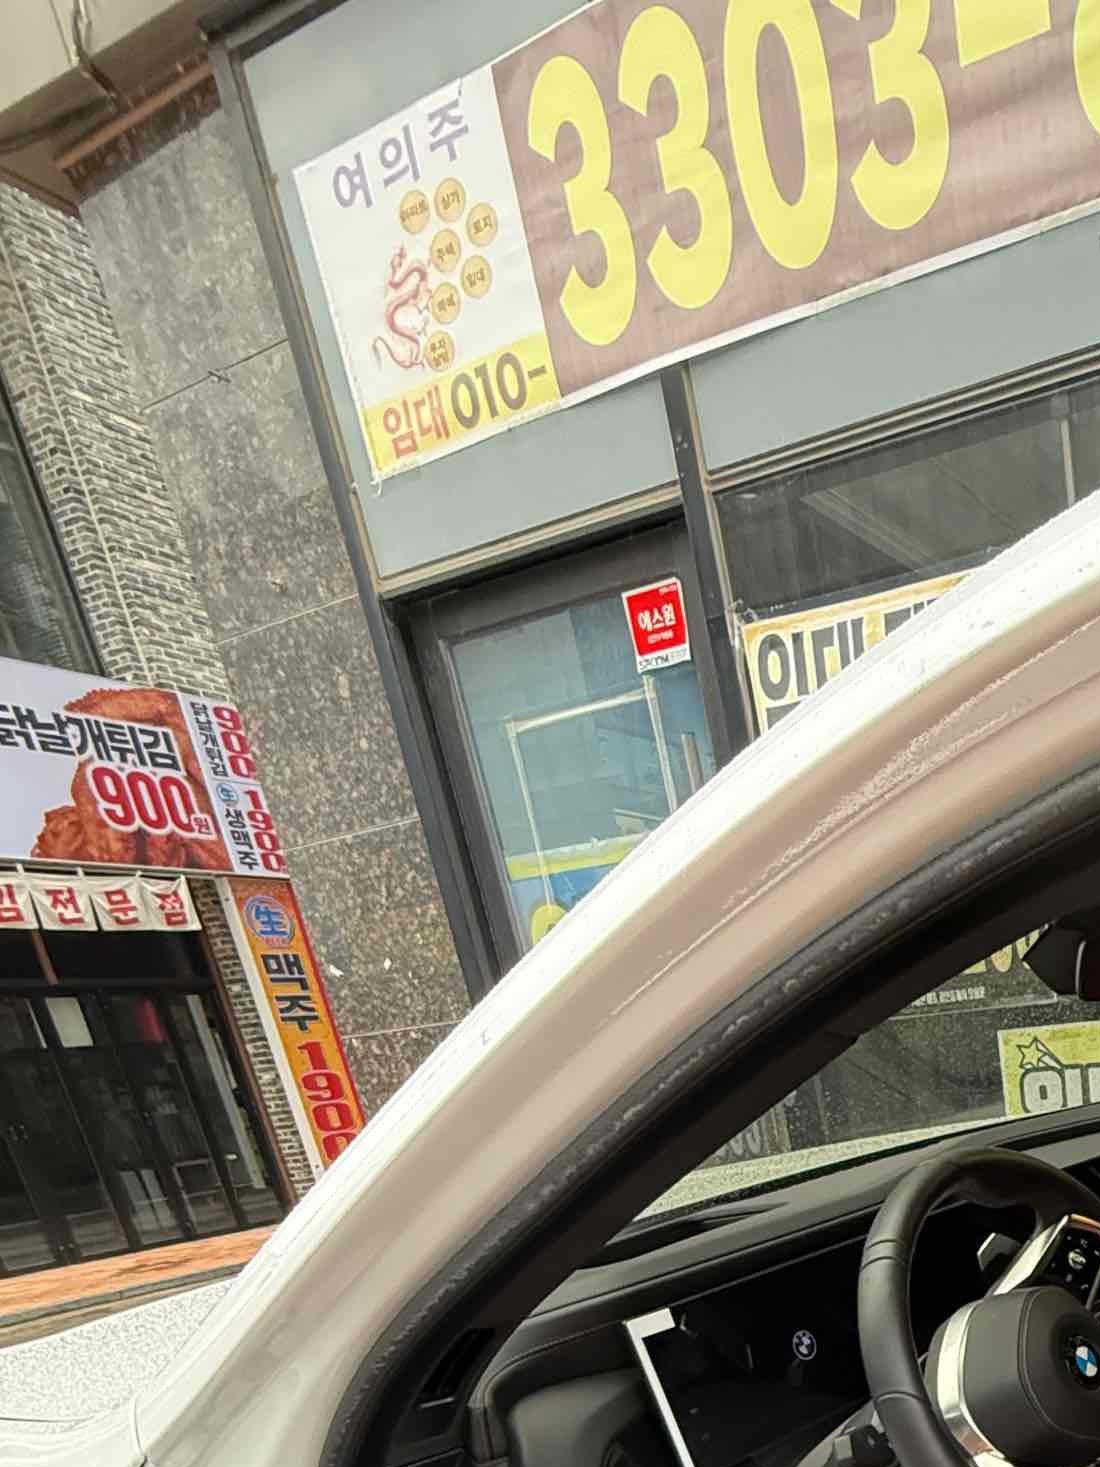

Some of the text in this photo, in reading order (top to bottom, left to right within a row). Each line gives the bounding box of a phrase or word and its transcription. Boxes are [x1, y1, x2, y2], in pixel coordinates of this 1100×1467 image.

[333, 98, 469, 208] 여의주
[383, 352, 547, 458] 임대 010-
[638, 603, 676, 631] 에스원
[225, 808, 259, 870] 생맥주
[261, 953, 320, 1032] 맥주
